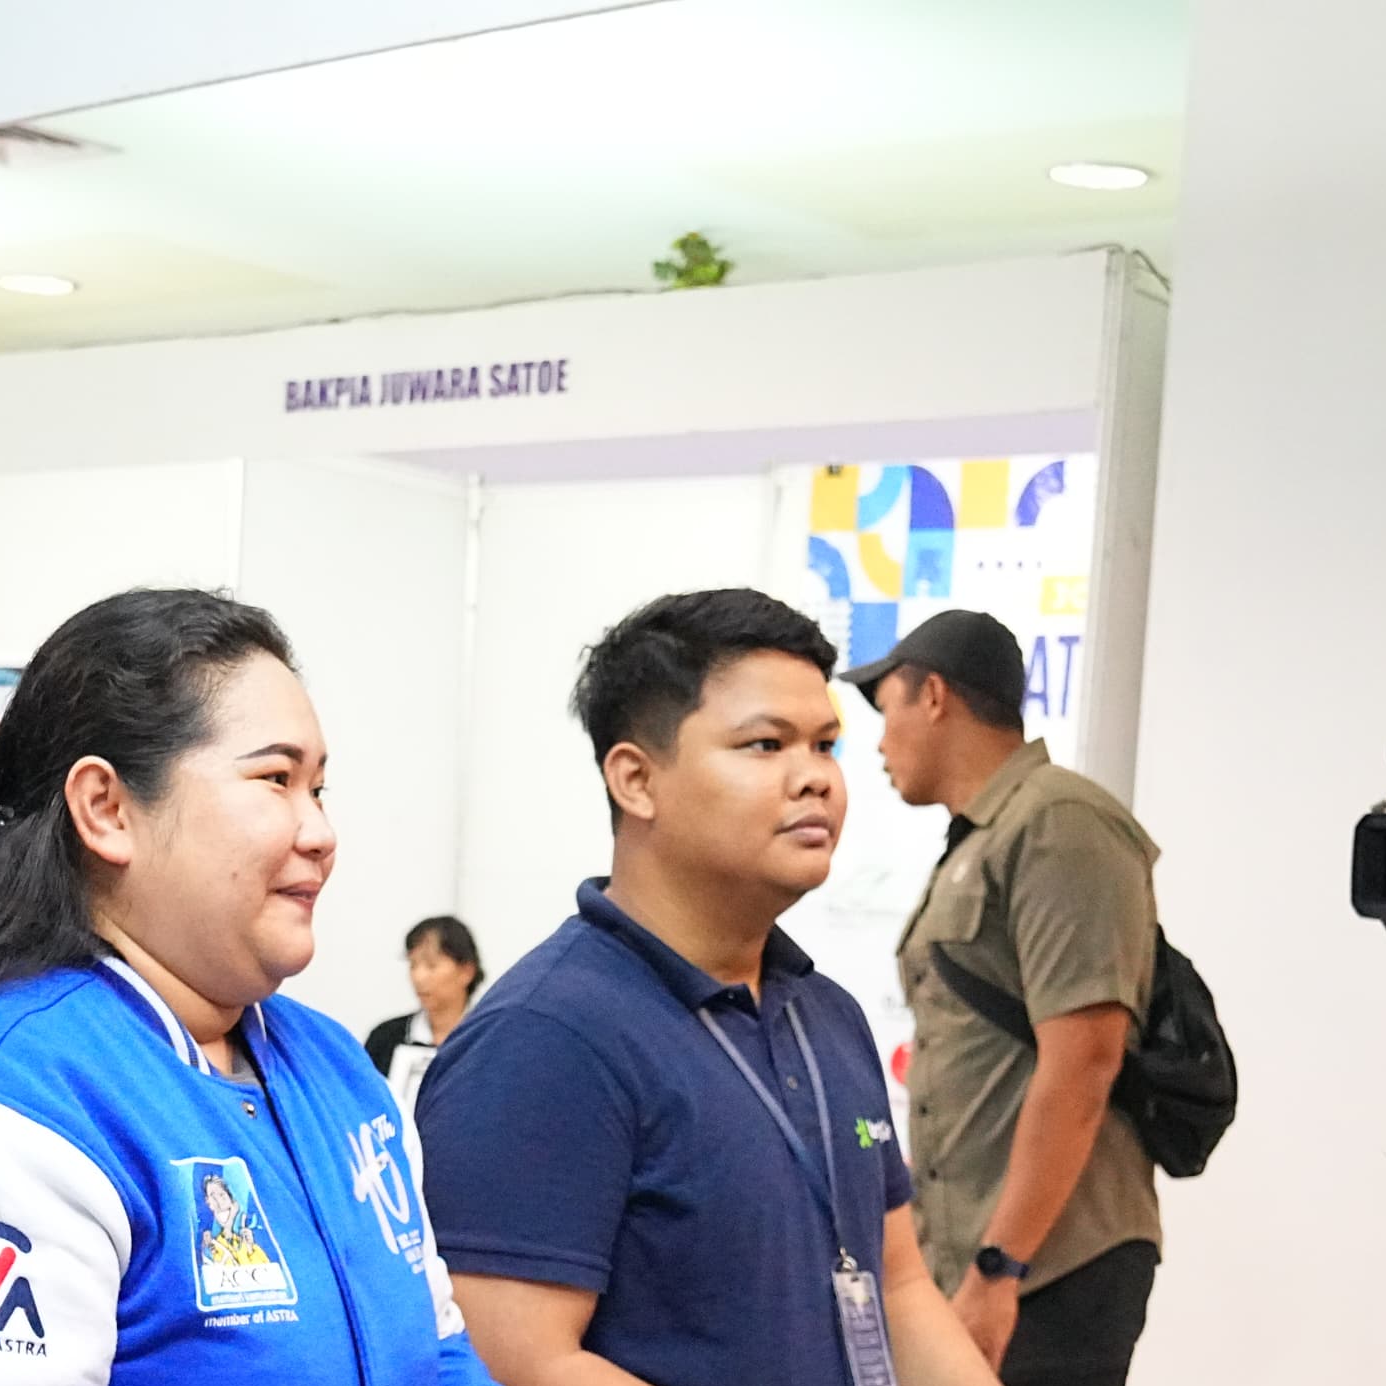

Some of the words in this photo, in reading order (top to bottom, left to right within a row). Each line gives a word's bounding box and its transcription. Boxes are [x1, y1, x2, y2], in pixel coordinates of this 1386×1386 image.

[285, 375, 371, 414] BAKPIA
[379, 365, 480, 407] JUWARA
[489, 358, 569, 398] SATOE
[203, 1313, 250, 1328] member
[252, 1309, 264, 1324] of
[265, 1309, 299, 1322] ASTRA
